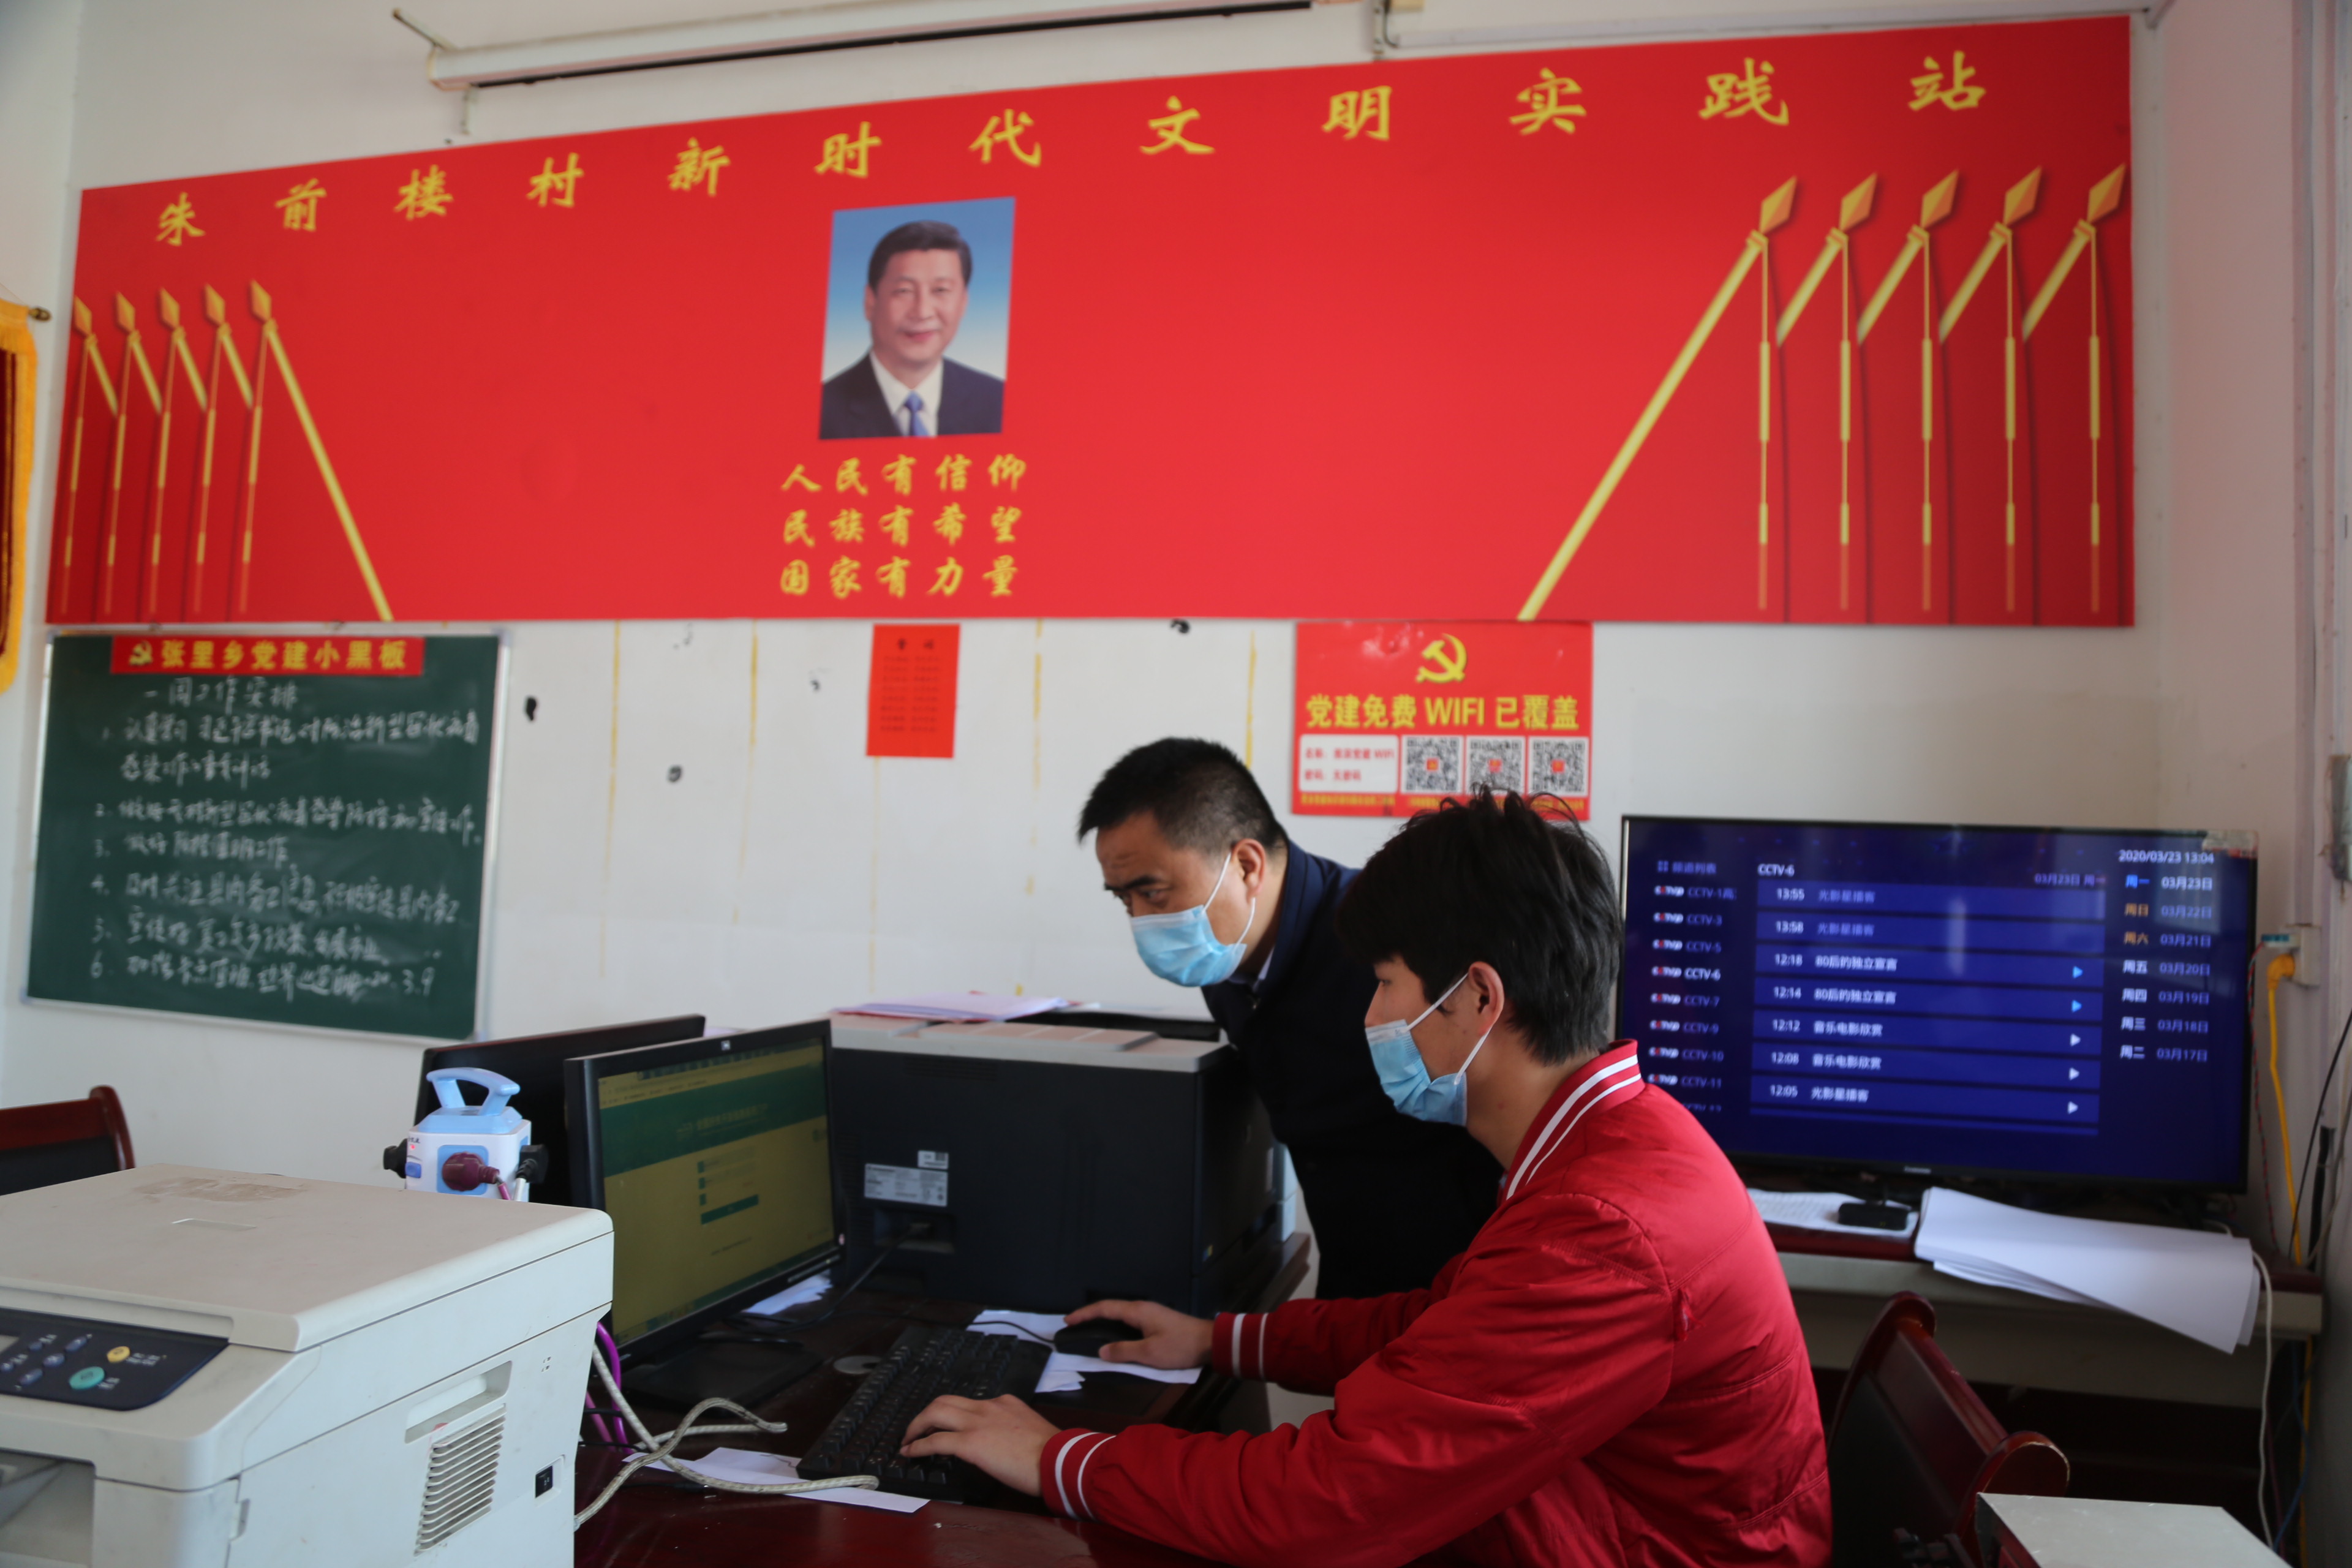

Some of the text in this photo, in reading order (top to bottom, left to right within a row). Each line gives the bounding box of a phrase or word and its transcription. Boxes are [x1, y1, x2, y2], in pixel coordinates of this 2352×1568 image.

[158, 52, 1984, 245] 朱前楼村新时代文明实践站
[782, 453, 1027, 496] 人民有信仰
[783, 502, 1022, 548] 民族有希望
[780, 554, 1018, 600] 国家有力量
[1305, 693, 1580, 731] 党建免费 WIFI 已覆盖
[2119, 850, 2214, 865] 2020/03/23 13:04
[1758, 863, 1795, 877] CCTV-6
[2034, 873, 2081, 886] 03月23日
[2125, 875, 2213, 891] 周一 03月23日
[2124, 903, 2212, 919] 周日 03月22日
[2123, 931, 2211, 948] 周六 03月21日
[1775, 954, 1803, 968] 12:18
[2123, 959, 2211, 976] 周五 03月20日
[1684, 968, 1721, 981] CCTV-6
[1774, 986, 1801, 1000] 12:14
[2122, 988, 2209, 1005] 周四 03月19日
[1773, 1019, 1800, 1033] 12:12
[2121, 1016, 2209, 1034] 周三 03月18日
[1771, 1052, 1800, 1066] 12:08
[2120, 1045, 2207, 1062] 周二 03月17日
[1770, 1085, 1798, 1098] 12:05
